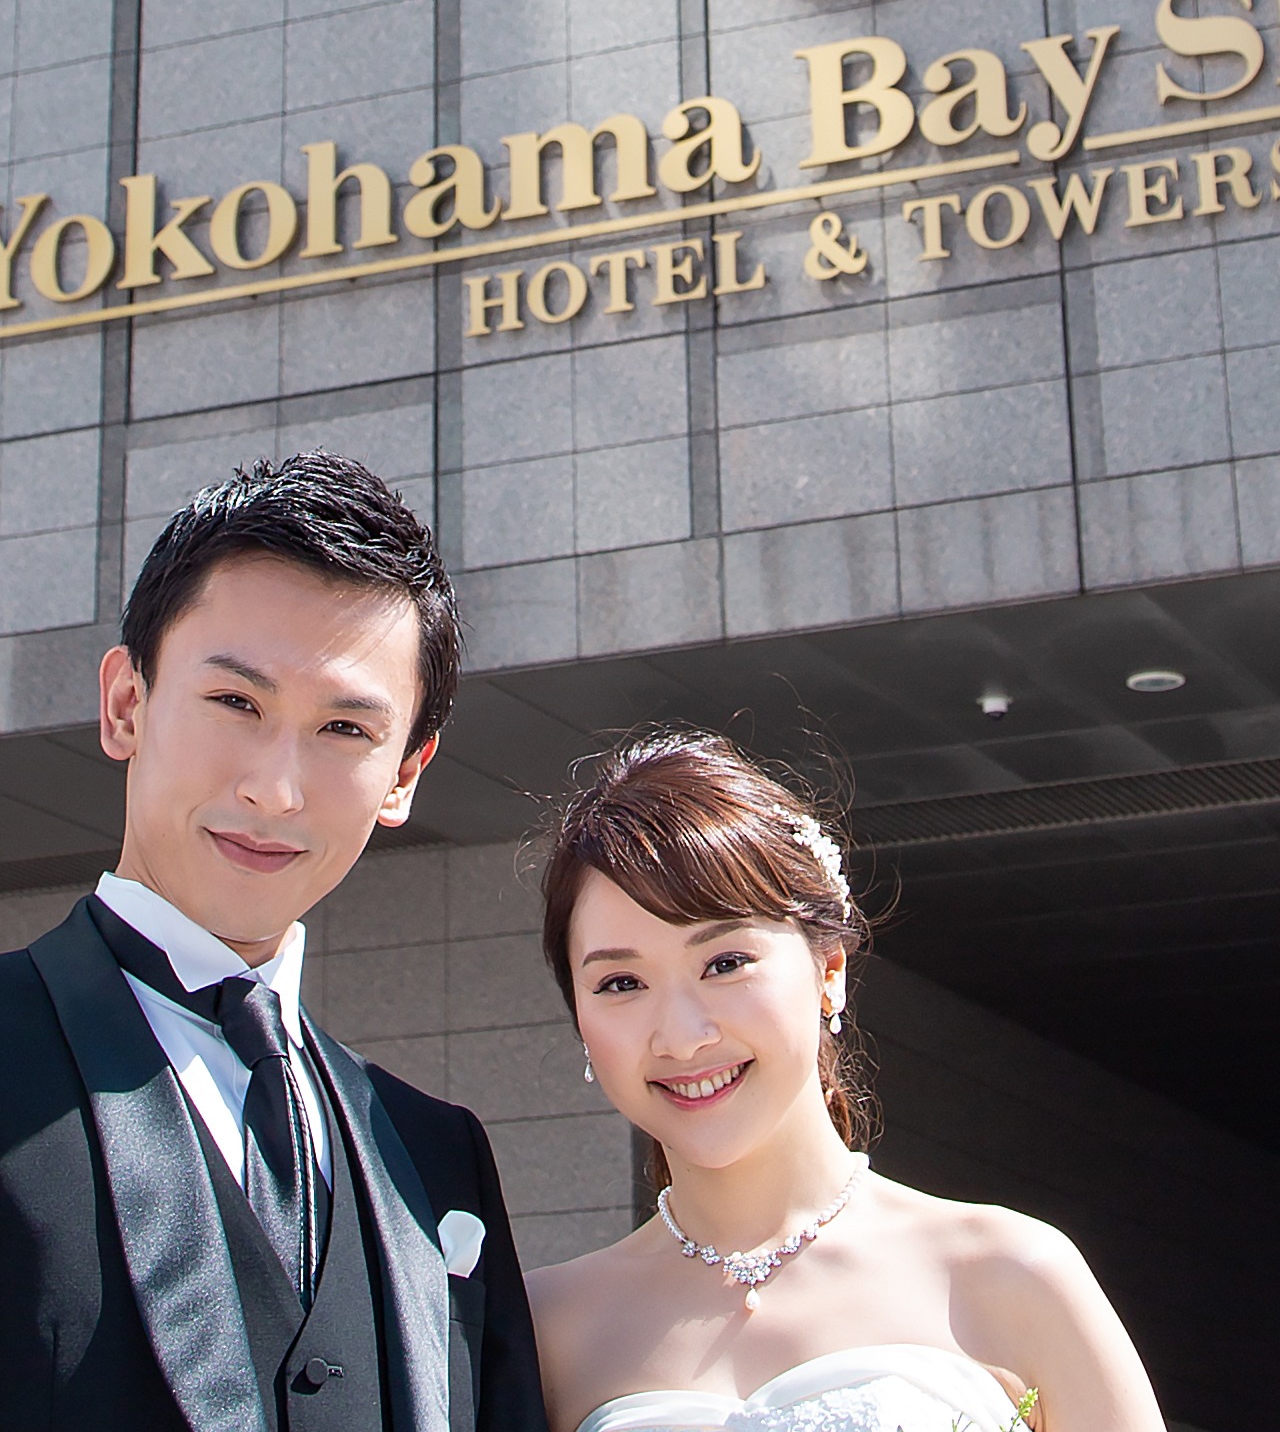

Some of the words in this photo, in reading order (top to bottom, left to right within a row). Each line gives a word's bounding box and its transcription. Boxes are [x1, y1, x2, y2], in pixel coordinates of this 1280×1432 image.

[793, 26, 1121, 170] Bay
[462, 232, 766, 338] HOTEL
[804, 210, 868, 280] &
